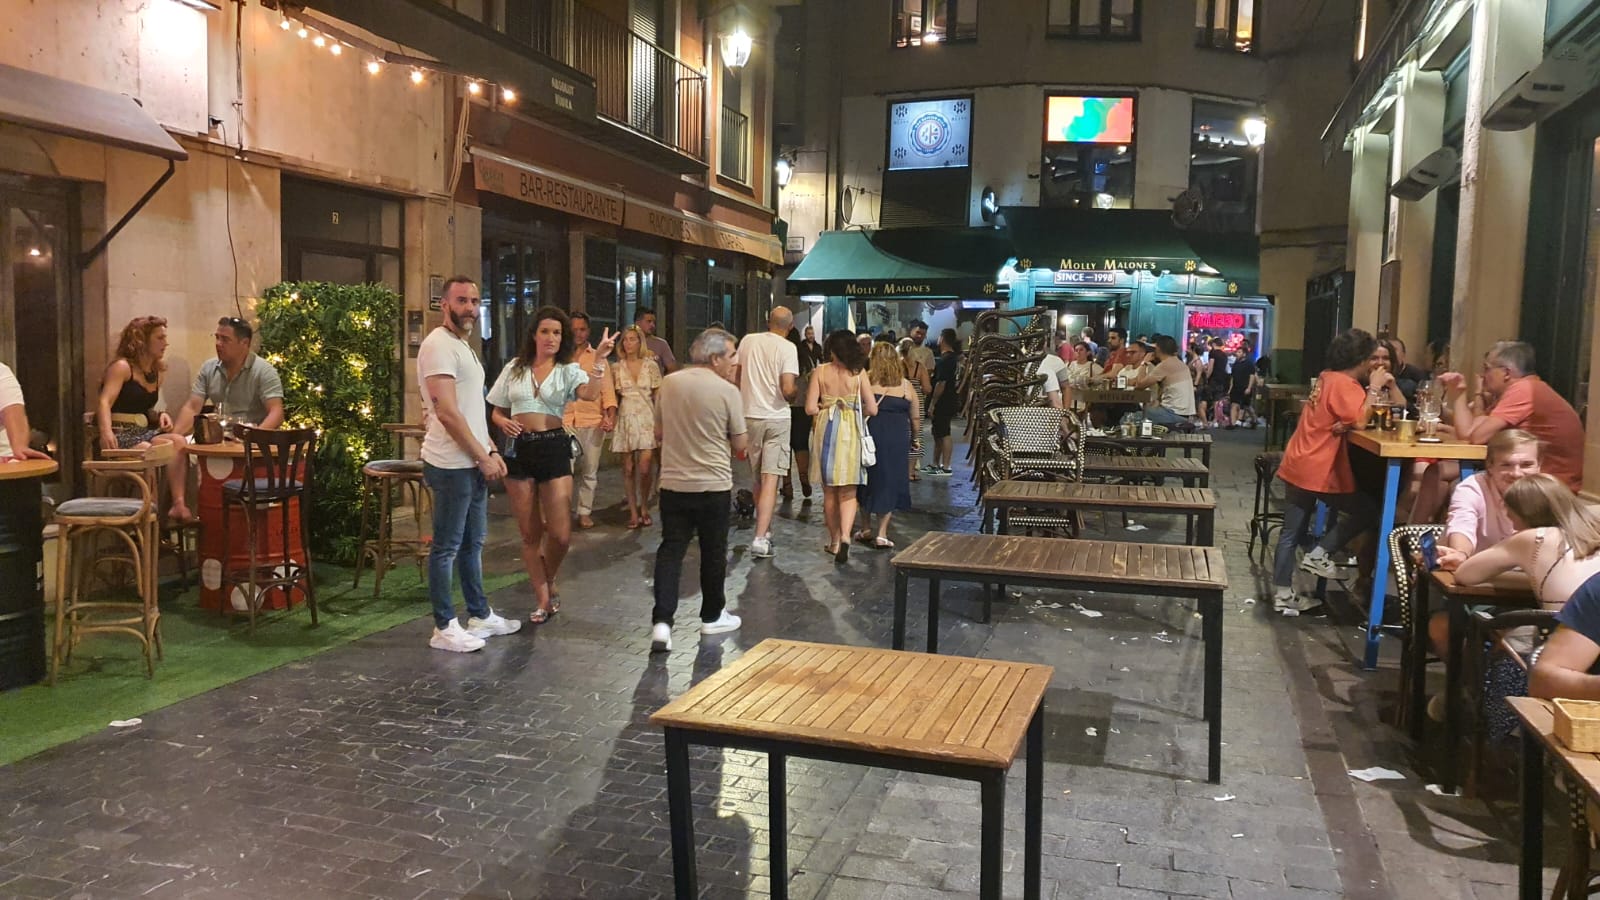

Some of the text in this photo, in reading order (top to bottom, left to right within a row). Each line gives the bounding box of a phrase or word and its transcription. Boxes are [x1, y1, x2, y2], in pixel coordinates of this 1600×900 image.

[519, 172, 618, 221] BAR-RESTAURANTE
[1060, 258, 1157, 270] MOLLY MALONE'S
[845, 283, 877, 295] MOLLY
